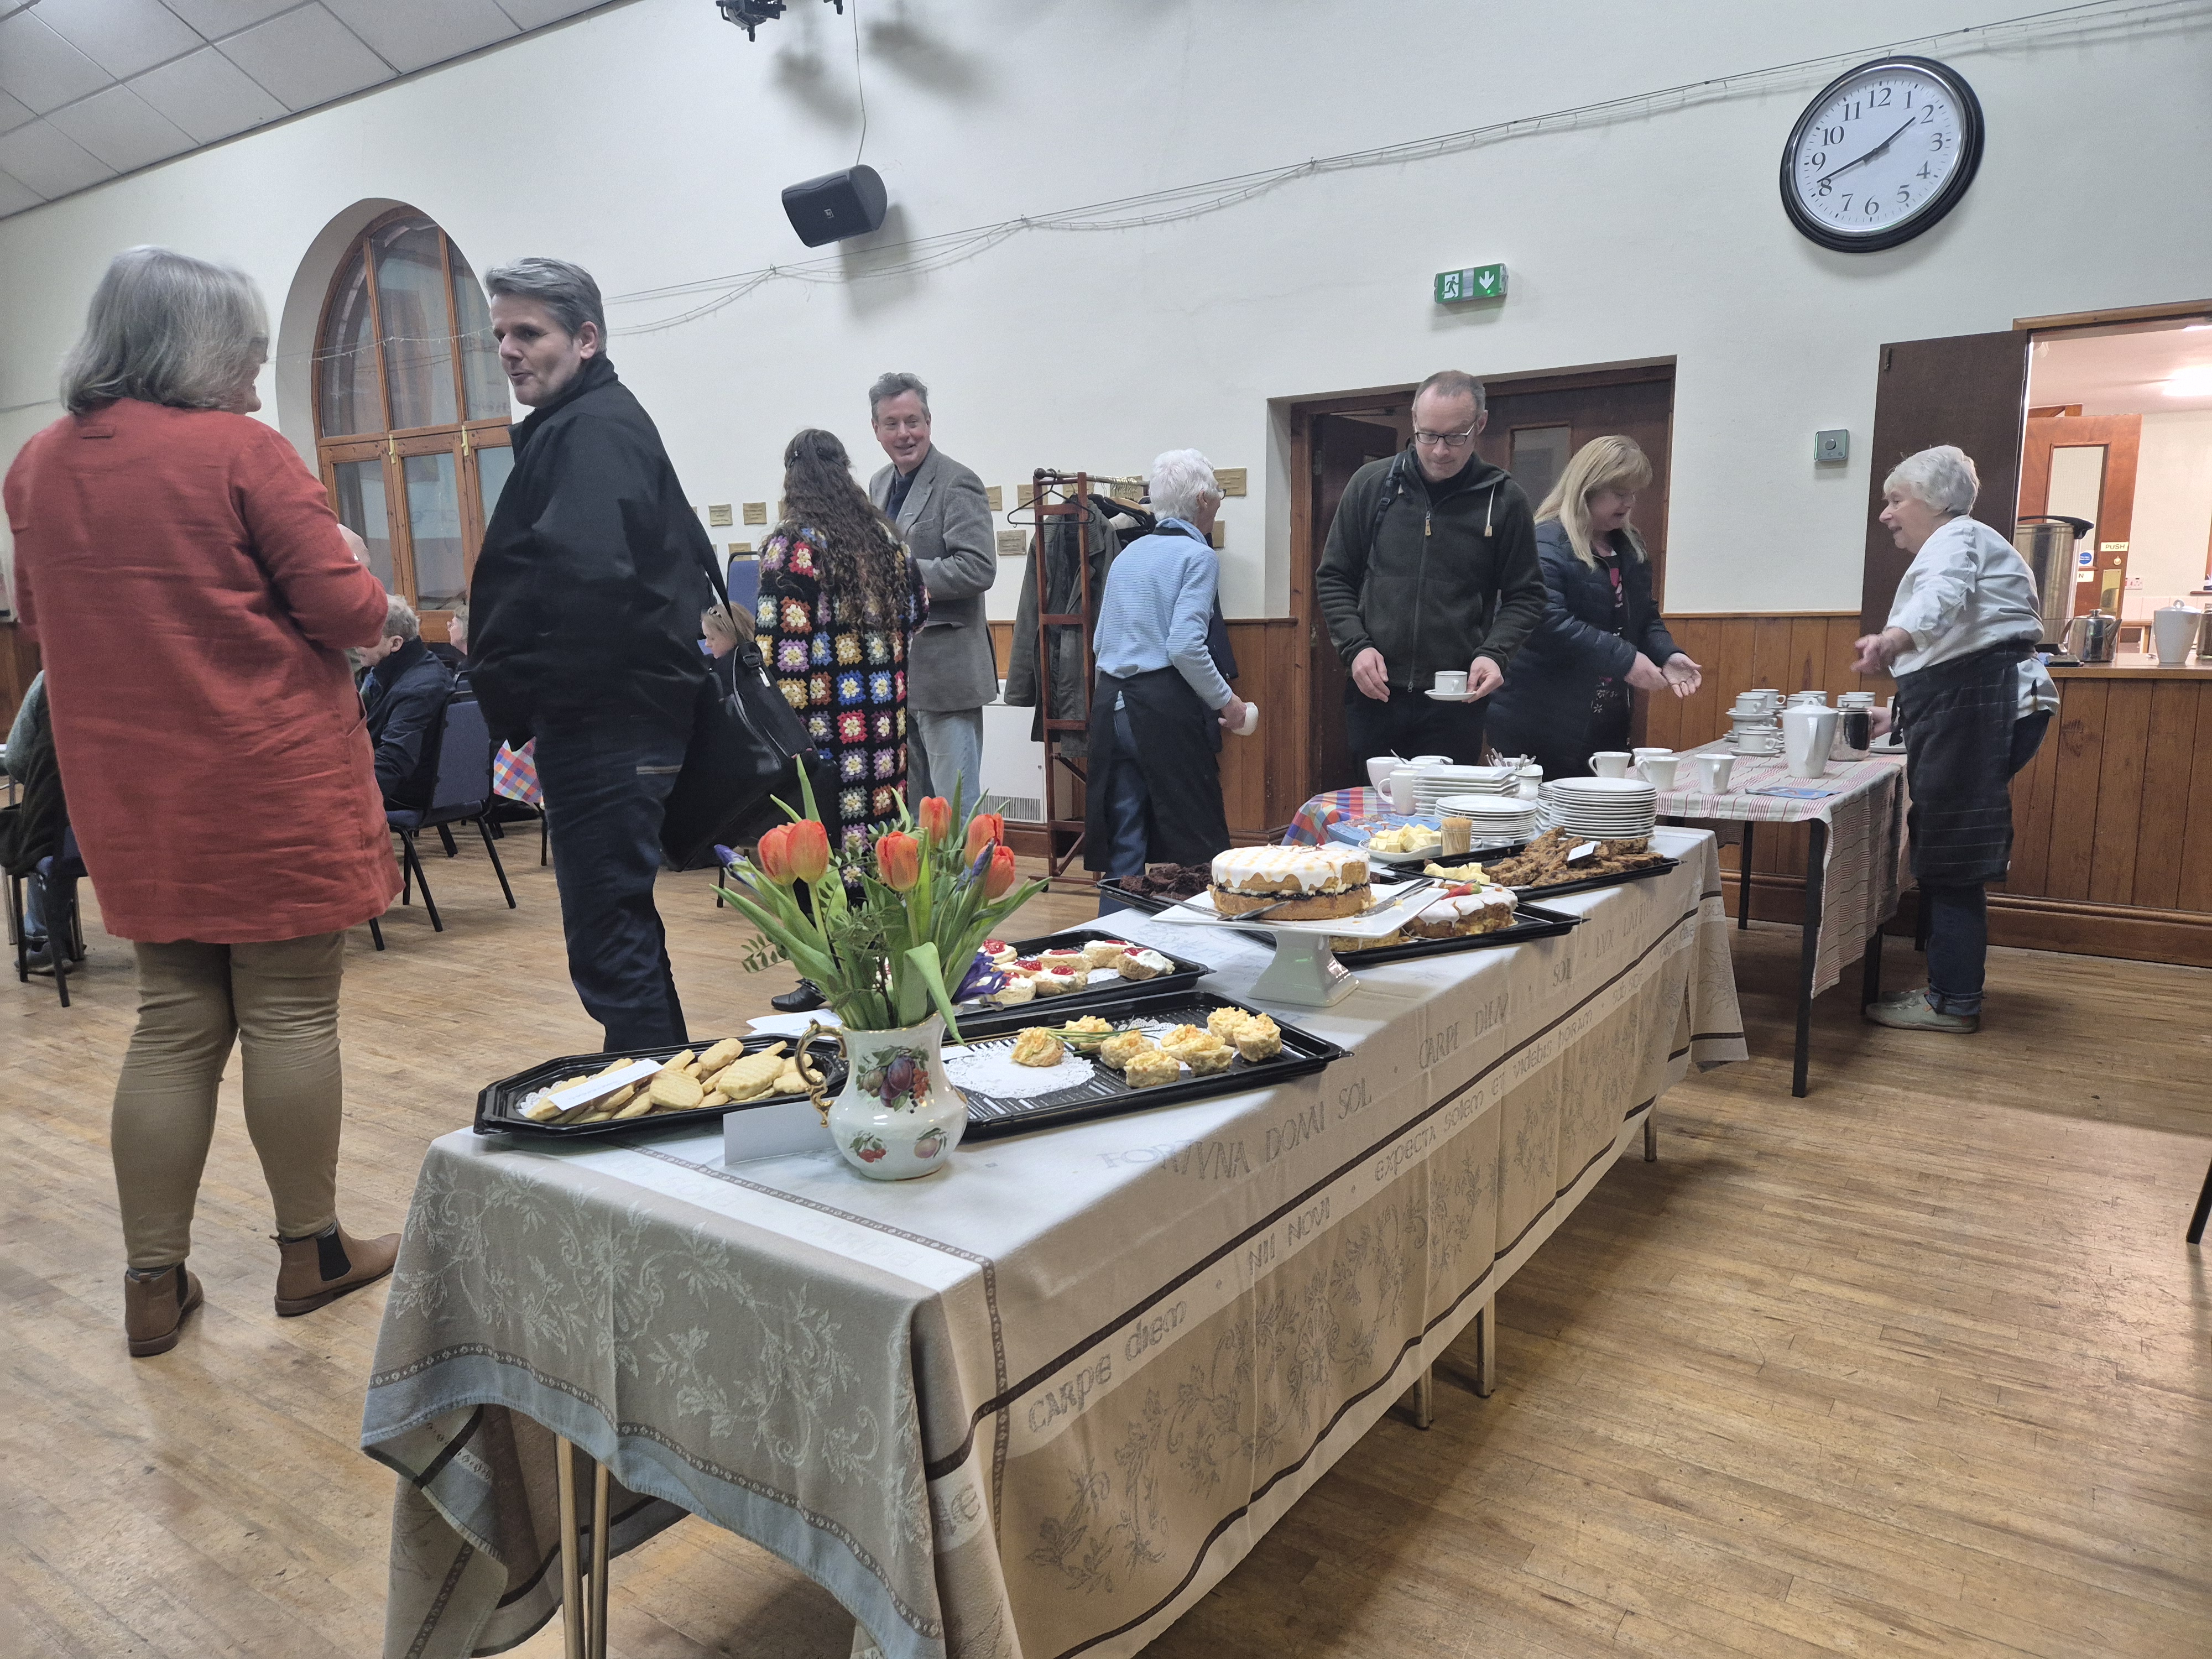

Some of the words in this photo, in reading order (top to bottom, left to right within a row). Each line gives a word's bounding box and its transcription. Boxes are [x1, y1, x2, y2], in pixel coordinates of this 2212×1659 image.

[1867, 87, 1891, 108] 12
[1903, 90, 1912, 109] 1
[1842, 101, 1863, 122] 11
[1919, 104, 1934, 124] 2
[1820, 126, 1845, 147] 10
[1929, 132, 1943, 152] 3
[1811, 152, 1826, 172] 9
[1915, 160, 1931, 180] 4
[1818, 177, 1833, 197] 8
[1896, 184, 1910, 203] 5
[1841, 193, 1854, 212] 7
[1864, 195, 1880, 215] 6
[1266, 1101, 1325, 1163] DOMI
[1338, 1077, 1371, 1119] SOL
[1419, 1020, 1460, 1069] CARPE
[1552, 957, 1573, 987] SOL
